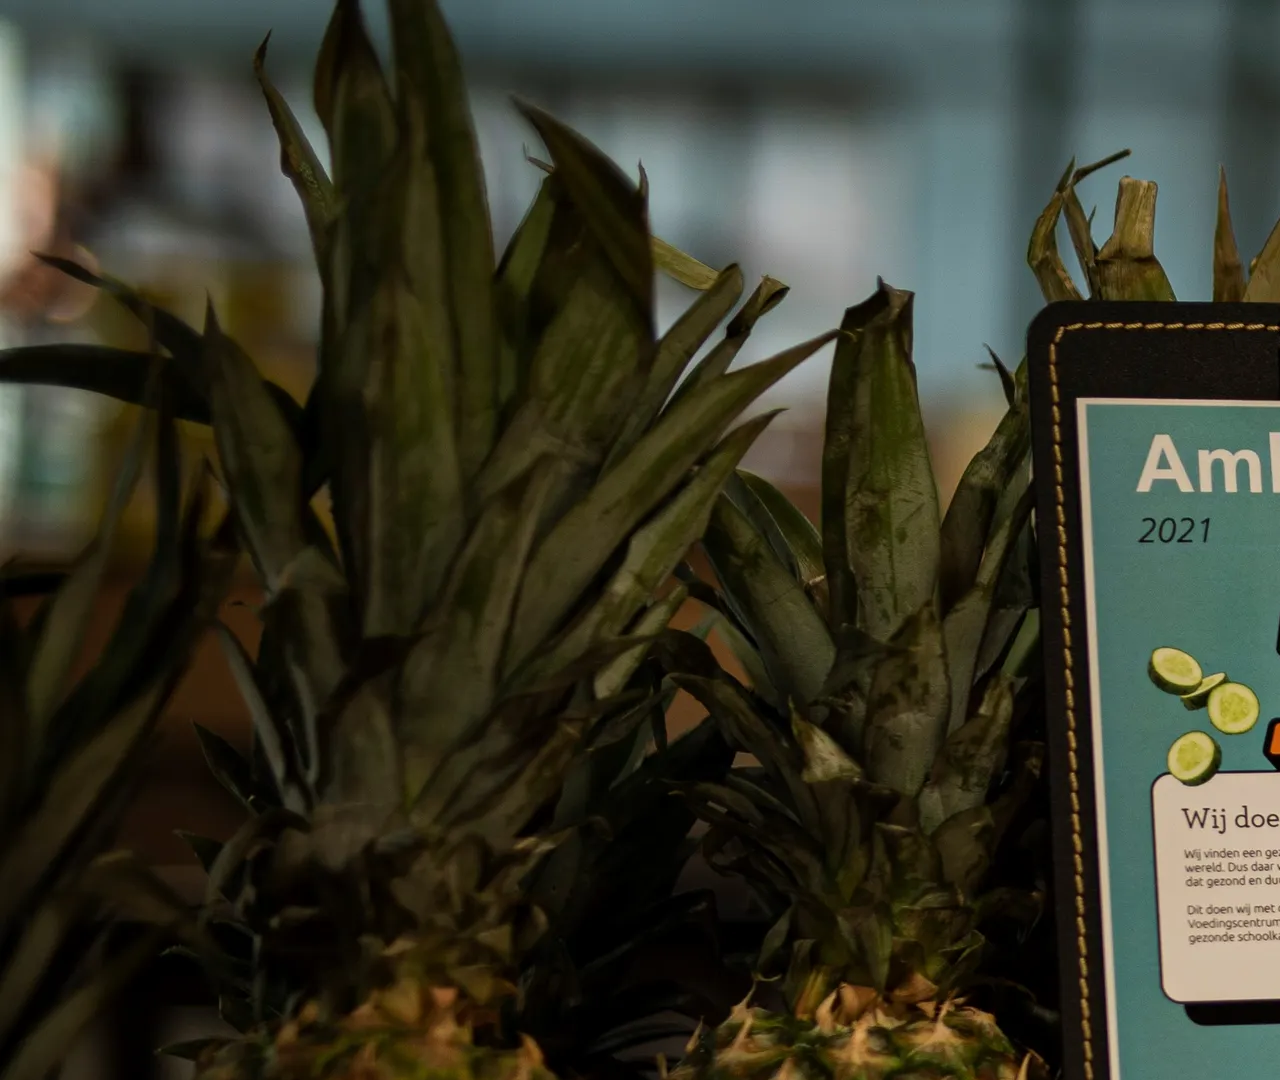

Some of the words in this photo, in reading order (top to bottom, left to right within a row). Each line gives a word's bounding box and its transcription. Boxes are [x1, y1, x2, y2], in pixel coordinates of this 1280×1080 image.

[1138, 517, 1211, 543] 2021
[1182, 808, 1227, 833] Wij
[1184, 849, 1202, 860] Wij
[1203, 848, 1240, 858] vinden
[1243, 849, 1262, 857] een
[1185, 862, 1225, 873] wereld.
[1228, 861, 1248, 872] Dus
[1251, 861, 1274, 872] daar
[1185, 876, 1203, 888] dat
[1207, 875, 1246, 888] gezond
[1249, 877, 1262, 885] en
[1187, 904, 1203, 915] Dit
[1206, 904, 1233, 915] doen
[1235, 903, 1251, 916] wij
[1254, 904, 1275, 914] met
[1188, 932, 1235, 944] gezonde
